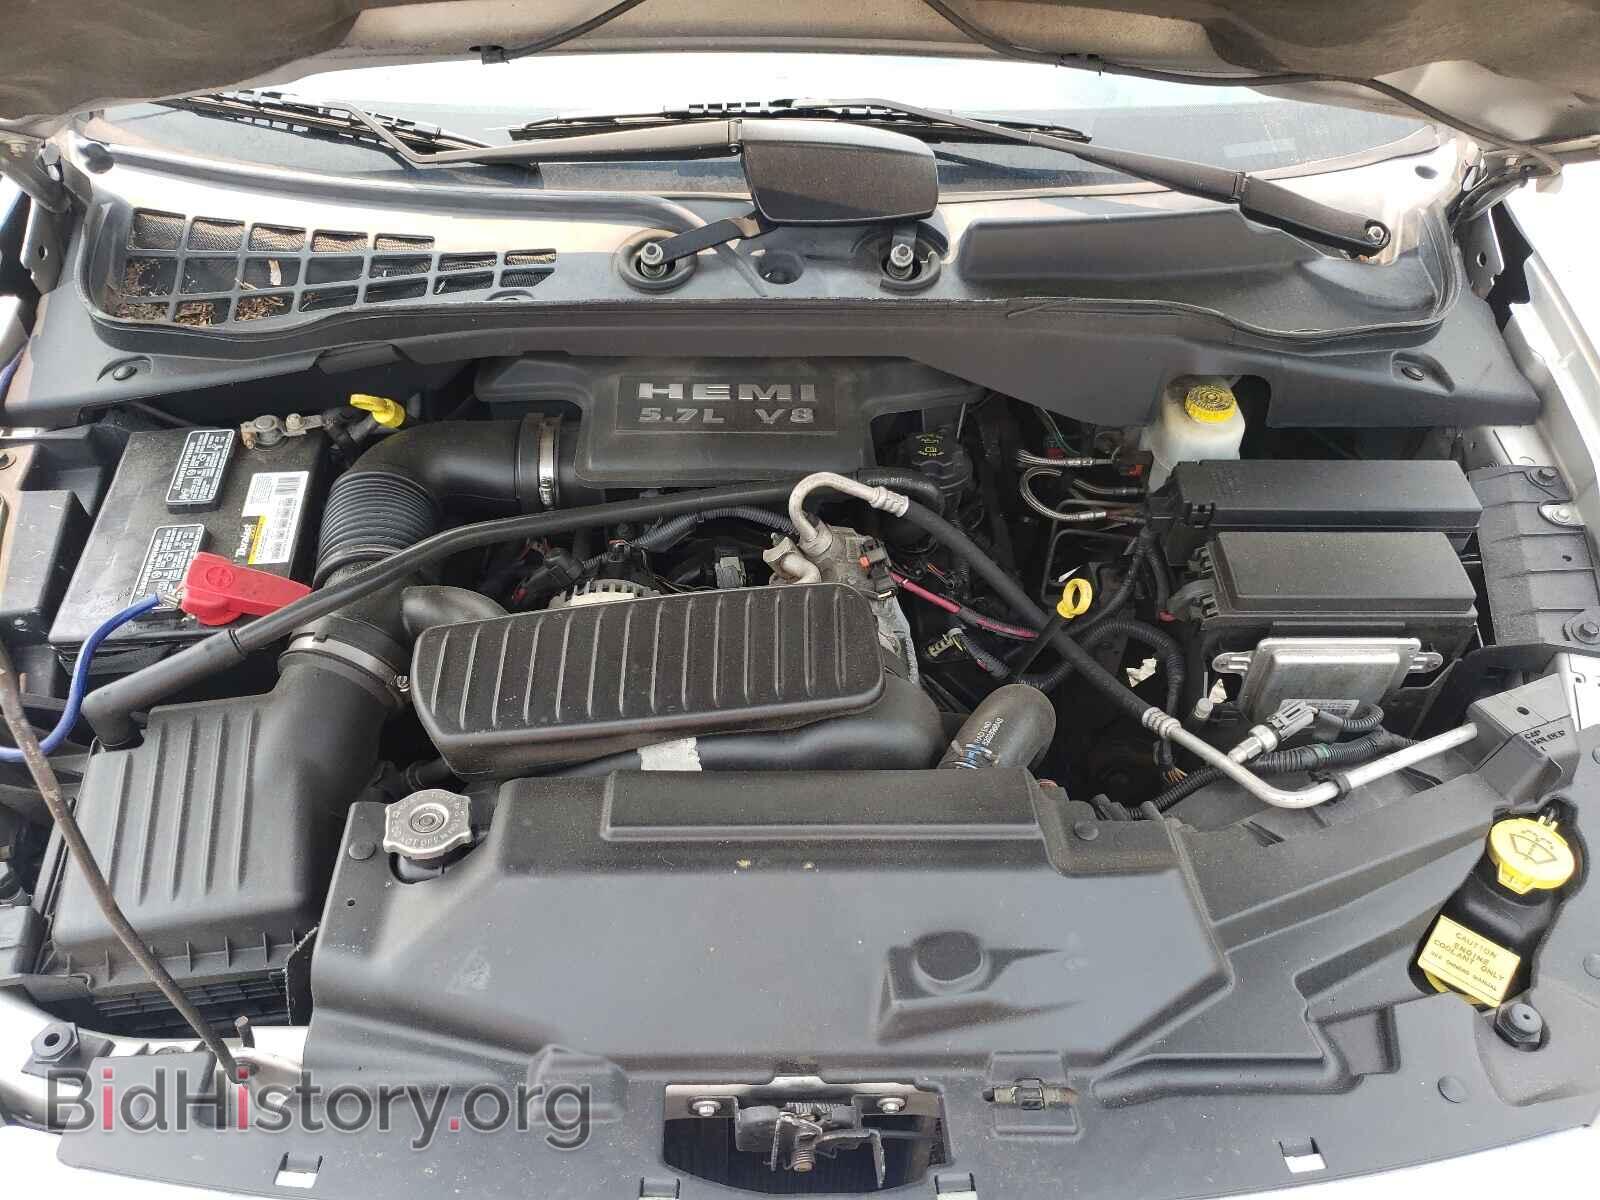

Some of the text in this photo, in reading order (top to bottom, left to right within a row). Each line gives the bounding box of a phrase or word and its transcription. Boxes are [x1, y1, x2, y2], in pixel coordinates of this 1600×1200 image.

[638, 383, 816, 401] HEMI
[638, 407, 815, 425] 5.7L V8
[1453, 942, 1490, 966] ENGINE
[1455, 932, 1497, 959] CAUTION
[1433, 939, 1505, 981] COOLANT ONLY
